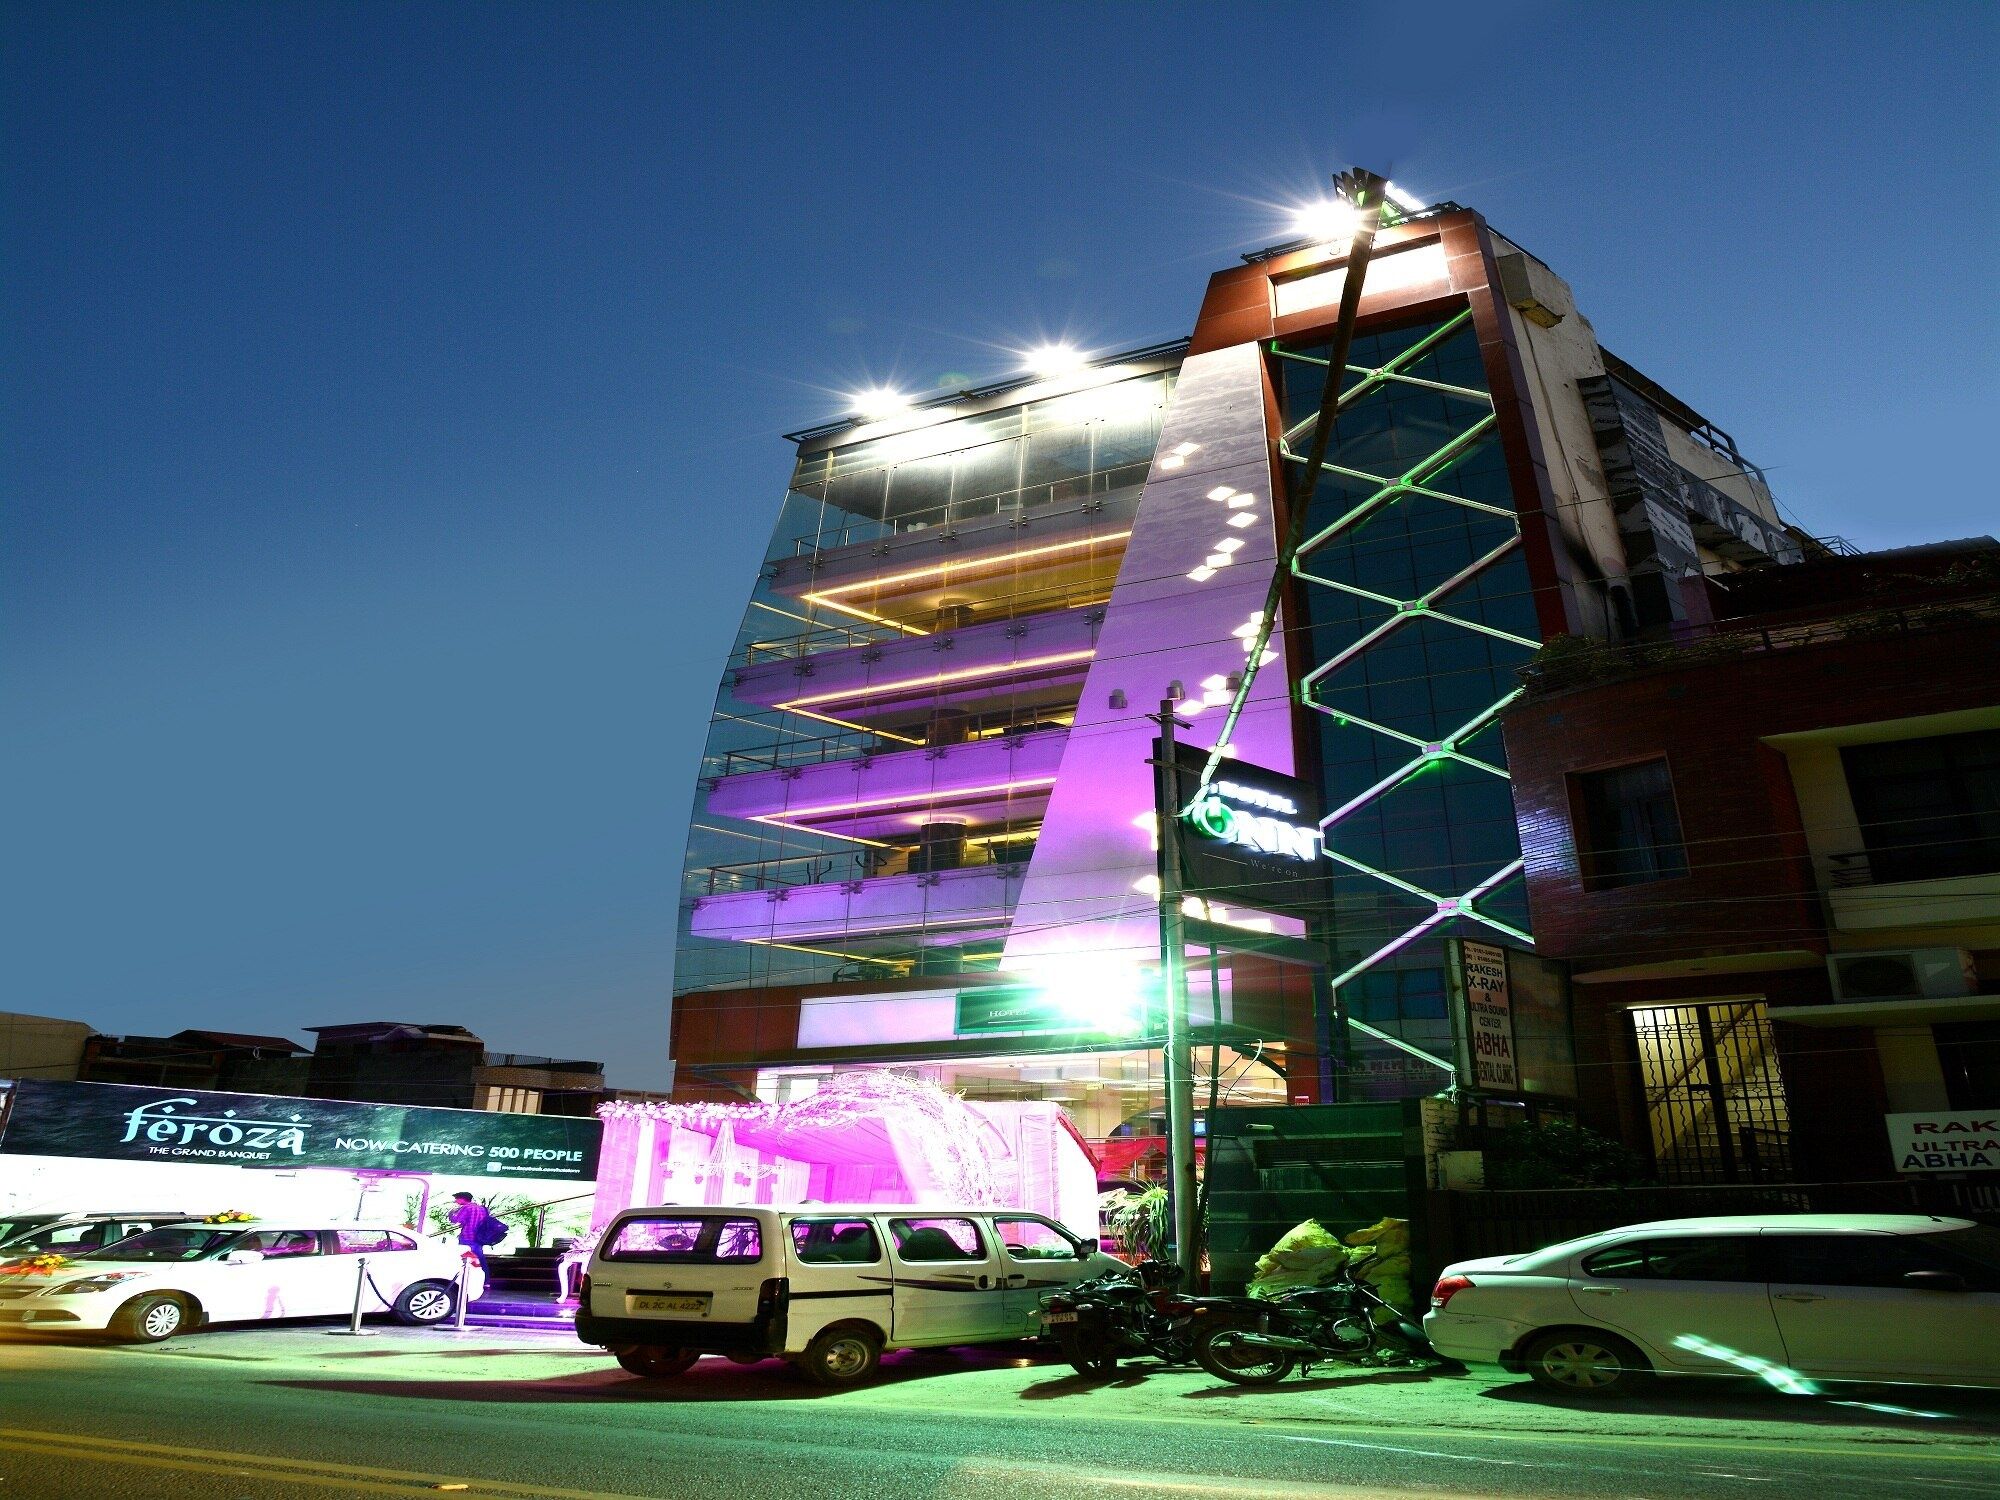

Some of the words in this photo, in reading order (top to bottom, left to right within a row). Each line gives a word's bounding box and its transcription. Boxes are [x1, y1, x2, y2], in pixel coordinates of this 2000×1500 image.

[1466, 962, 1503, 978] RAKESH
[1468, 976, 1504, 993] X-RAY
[1485, 993, 1492, 1002] &
[1488, 1004, 1508, 1017] SOUND
[1476, 1031, 1511, 1058] ABHA
[148, 1146, 170, 1155] THE
[171, 1147, 216, 1157] GRAND
[218, 1149, 272, 1160] BANQUET
[335, 1137, 387, 1152] NOW
[392, 1140, 485, 1157] CATERING
[488, 1146, 520, 1159] 500
[523, 1148, 583, 1162] PEOPLE
[1912, 1140, 2000, 1152] ULTRA
[1902, 1152, 1994, 1169] ABHA
